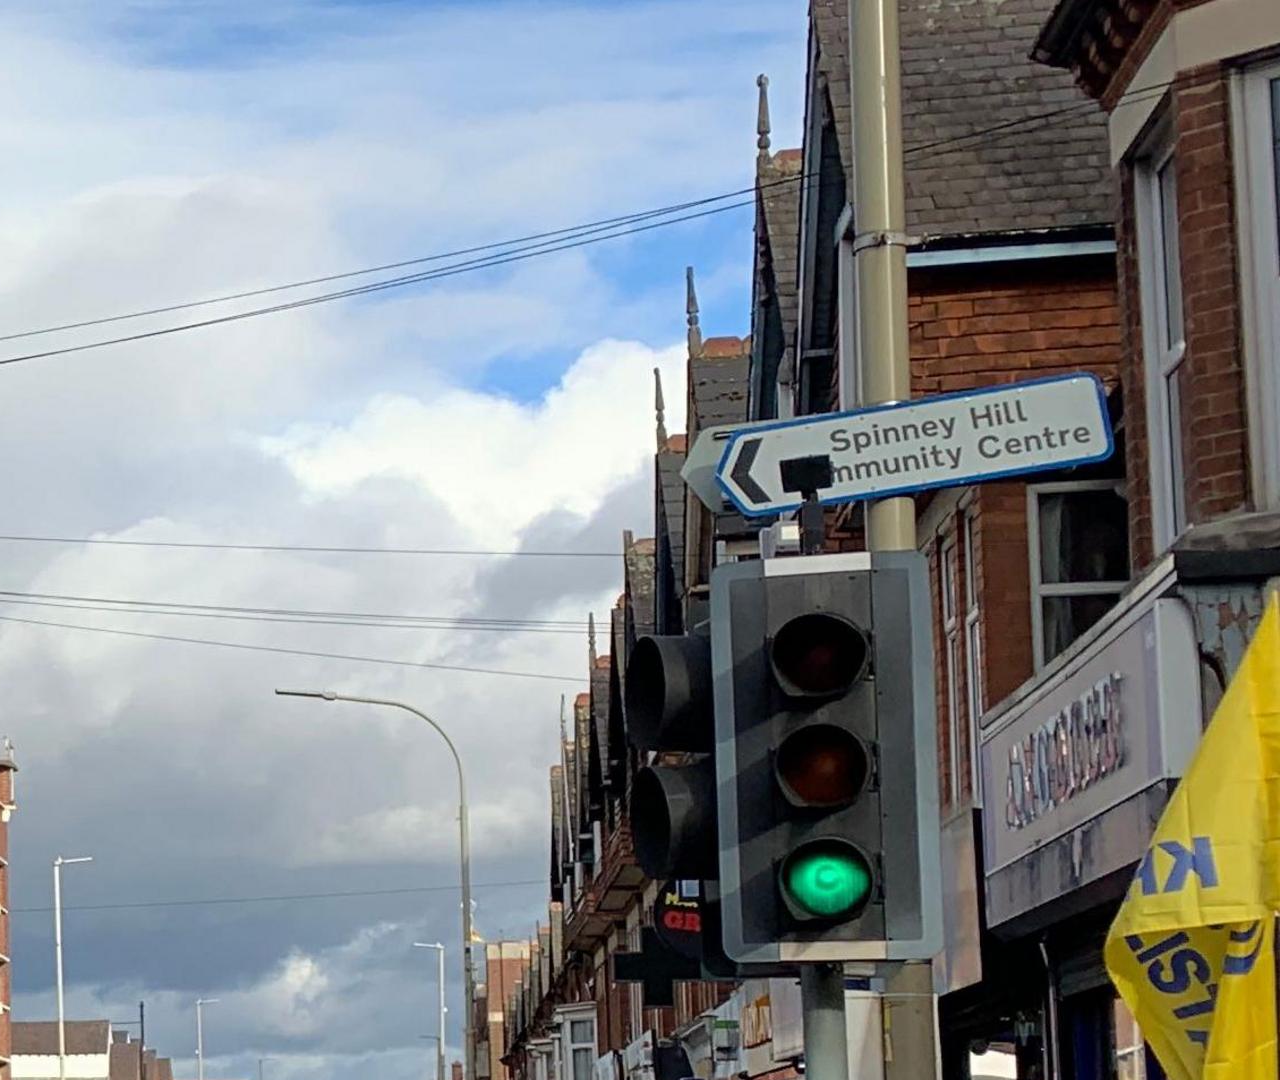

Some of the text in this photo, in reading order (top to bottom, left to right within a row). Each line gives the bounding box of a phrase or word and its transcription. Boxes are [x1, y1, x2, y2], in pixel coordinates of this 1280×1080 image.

[830, 399, 1028, 453] Spinney Hill
[832, 426, 1091, 483] mmunity Centre
